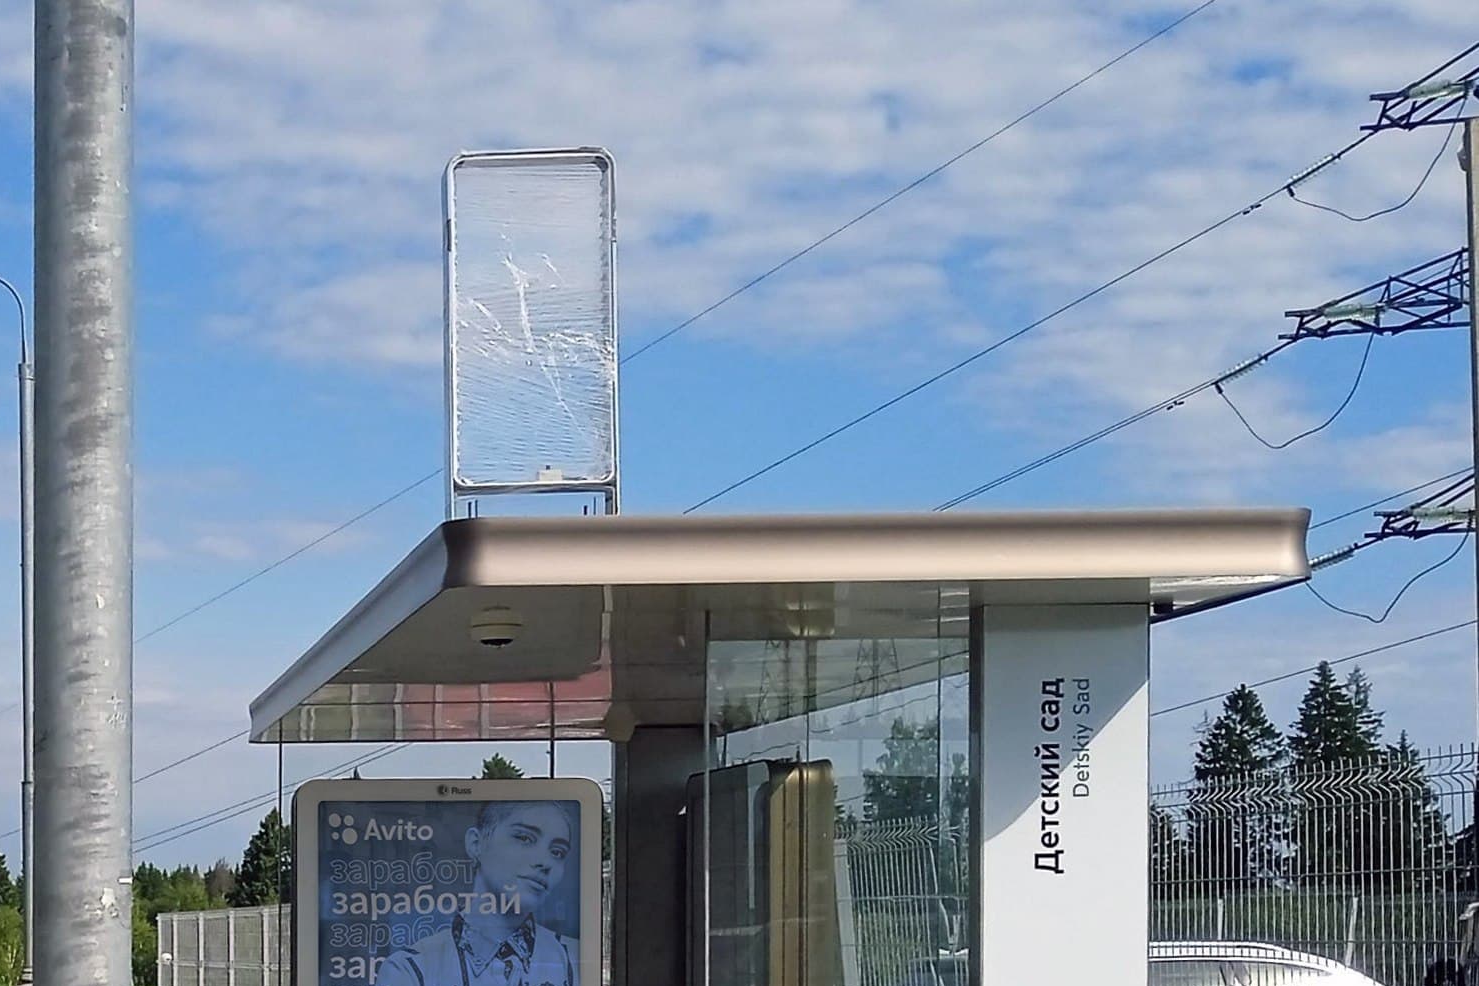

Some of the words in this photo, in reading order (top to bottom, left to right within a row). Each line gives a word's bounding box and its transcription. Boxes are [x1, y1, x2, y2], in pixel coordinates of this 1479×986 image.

[1041, 678, 1065, 731] сад
[1073, 679, 1090, 715] Sad
[1072, 724, 1093, 797] Detskiy
[364, 818, 434, 841] Avito
[1034, 743, 1064, 874] Детский
[332, 885, 521, 920] заработай
